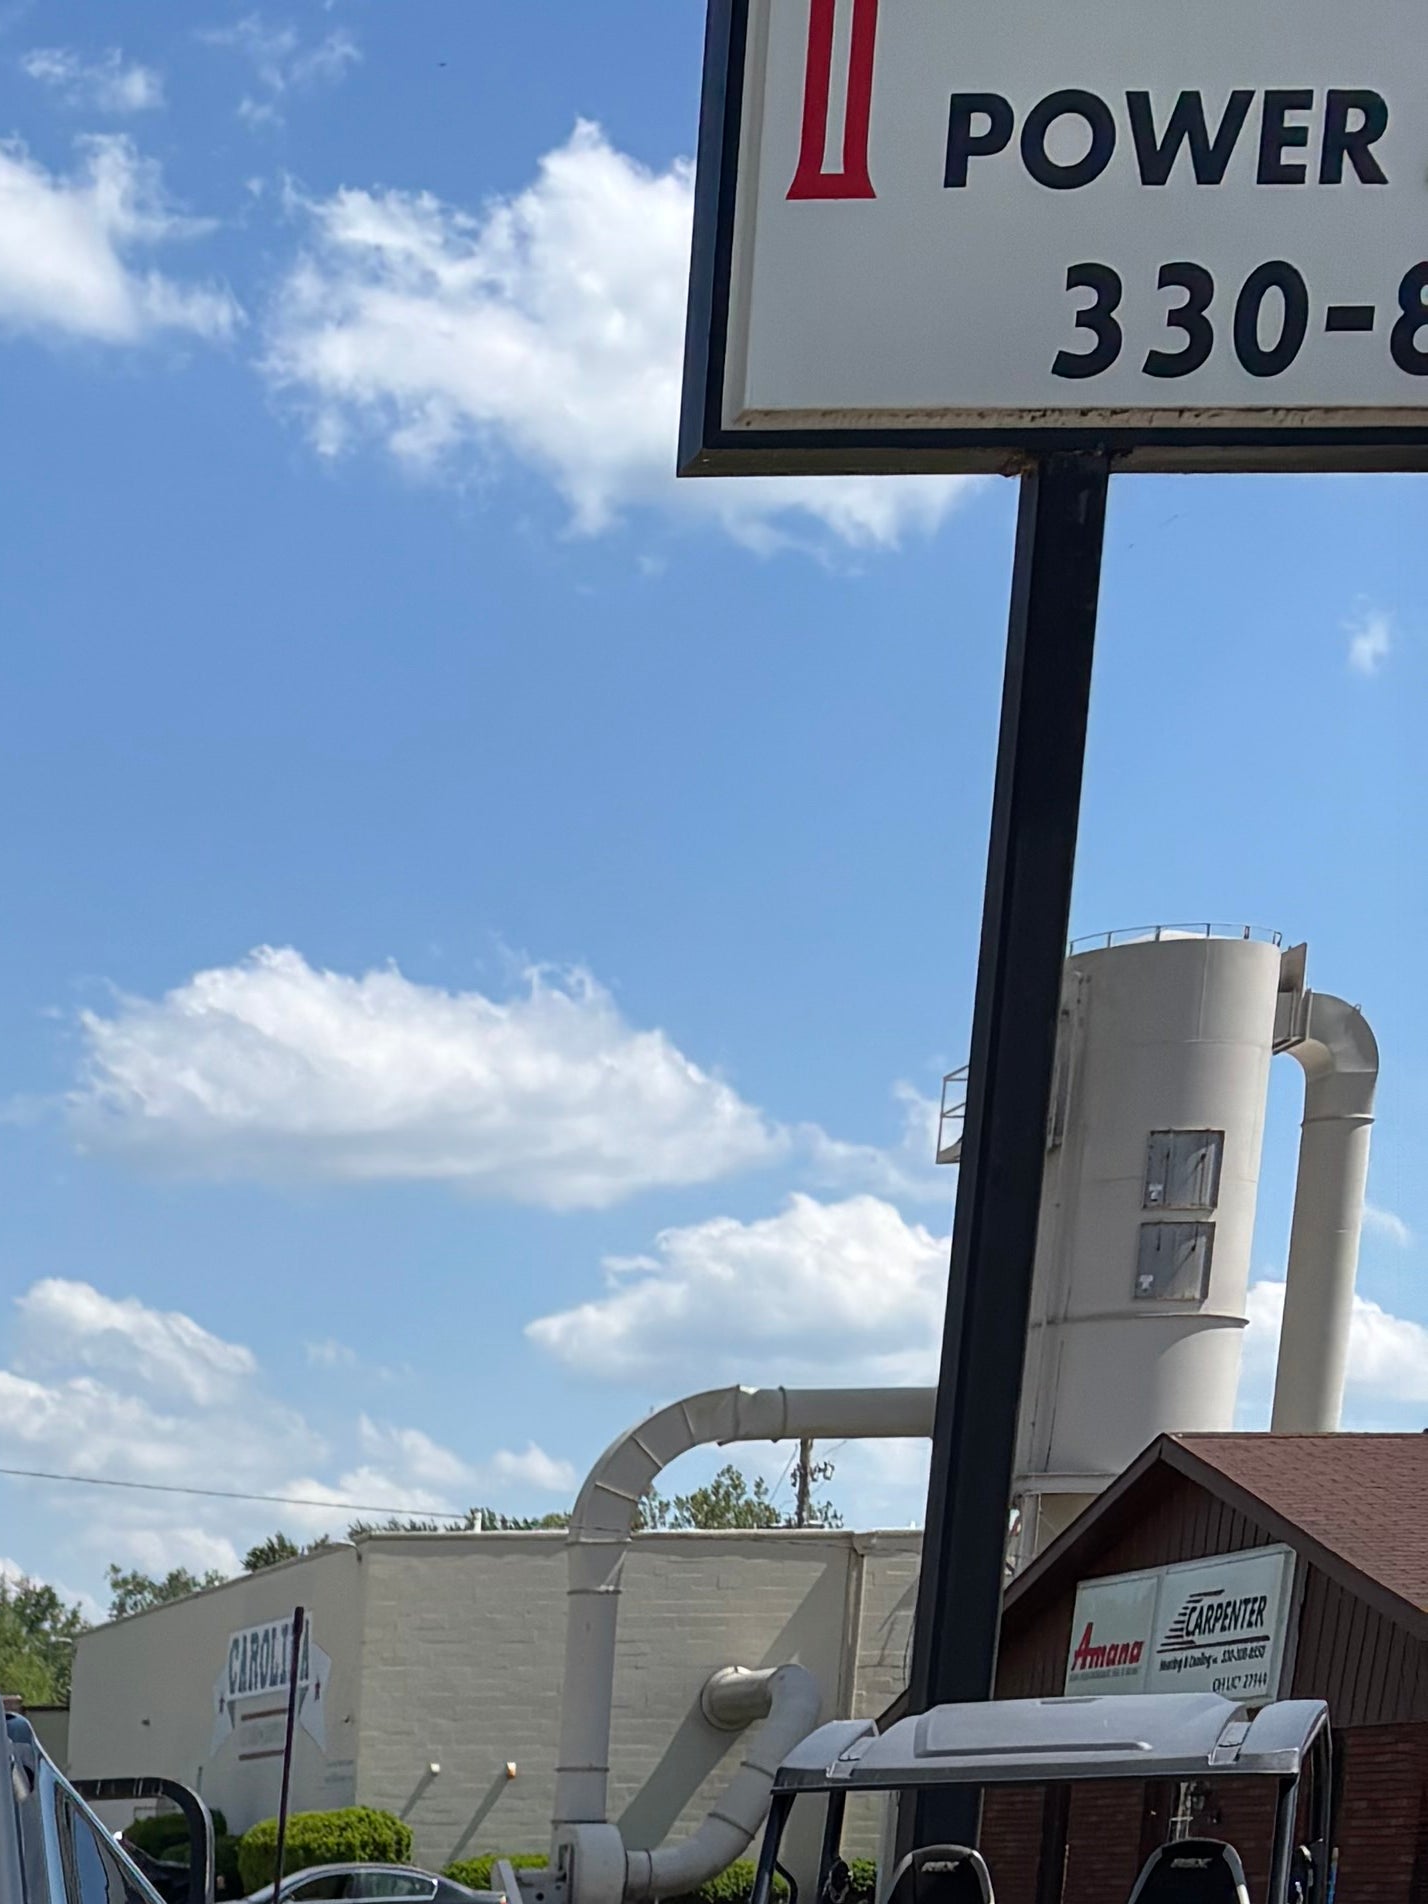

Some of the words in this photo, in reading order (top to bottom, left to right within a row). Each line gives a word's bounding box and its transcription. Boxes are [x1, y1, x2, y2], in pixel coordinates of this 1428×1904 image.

[943, 88, 1389, 190] POWER
[1071, 1621, 1145, 1672] Amana
[1185, 1595, 1268, 1638] CARPENTER
[228, 1617, 310, 1696] CAROLIA
